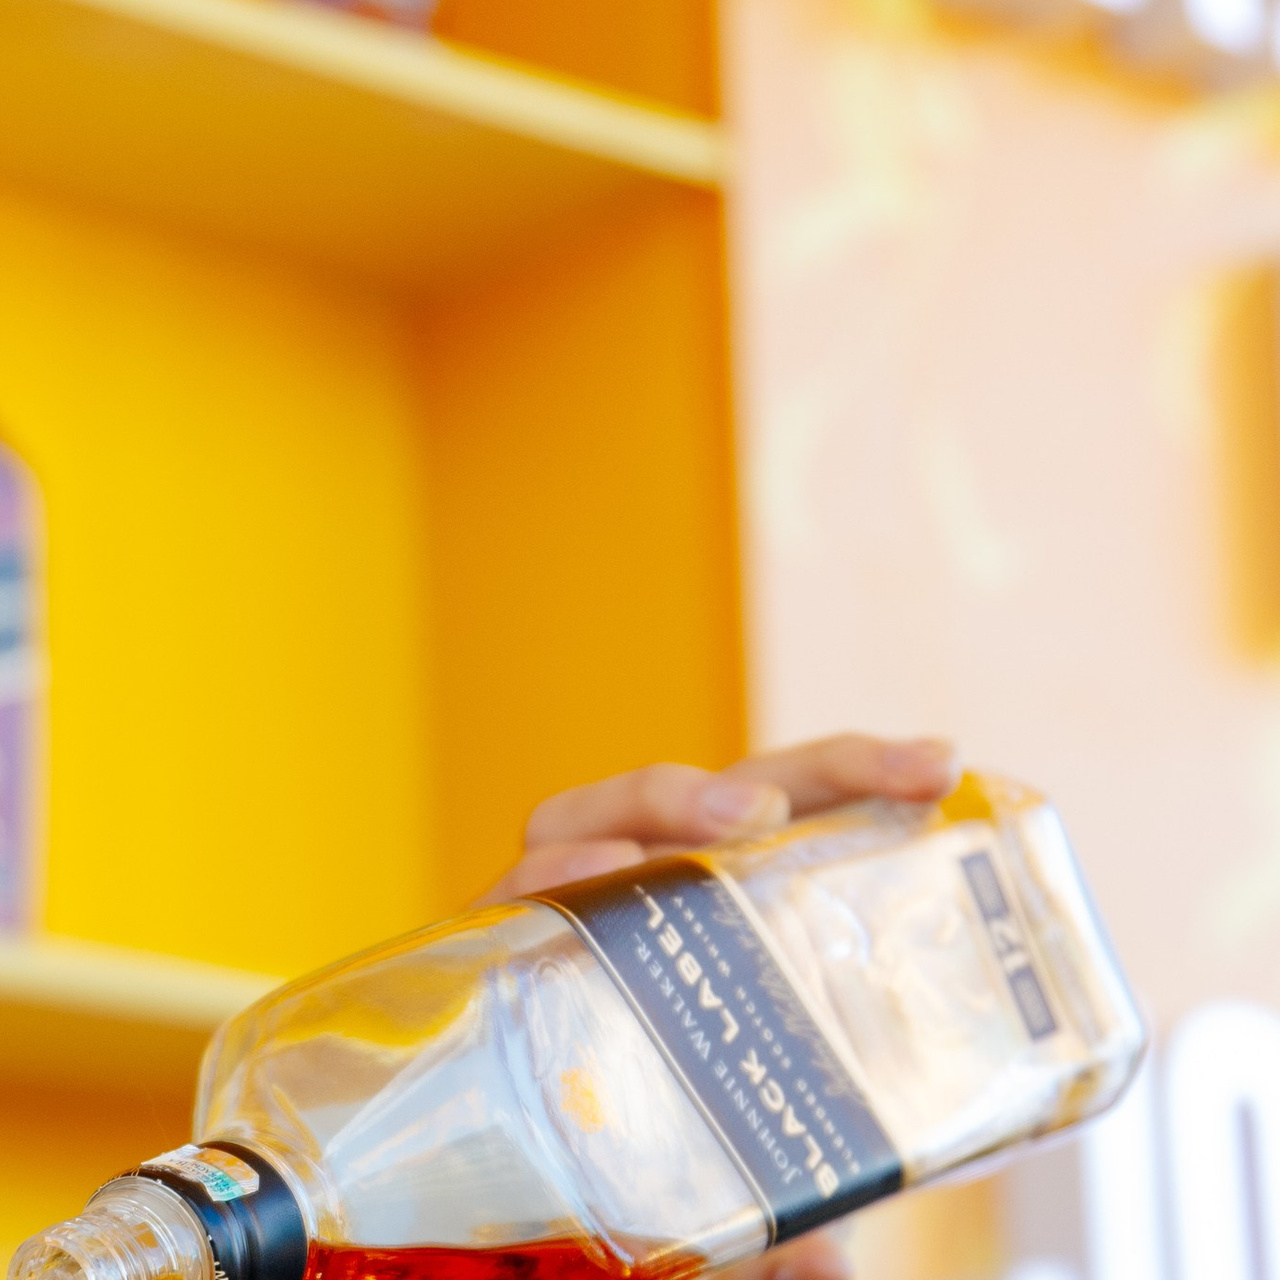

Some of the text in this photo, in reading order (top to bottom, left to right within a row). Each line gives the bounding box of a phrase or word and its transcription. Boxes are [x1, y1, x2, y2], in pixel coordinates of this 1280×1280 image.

[671, 894, 733, 978] WHISKY
[646, 894, 843, 1200] BLACK LABEL
[733, 985, 793, 1070] SCOTCH
[710, 1060, 804, 1186] JOHNNIE
